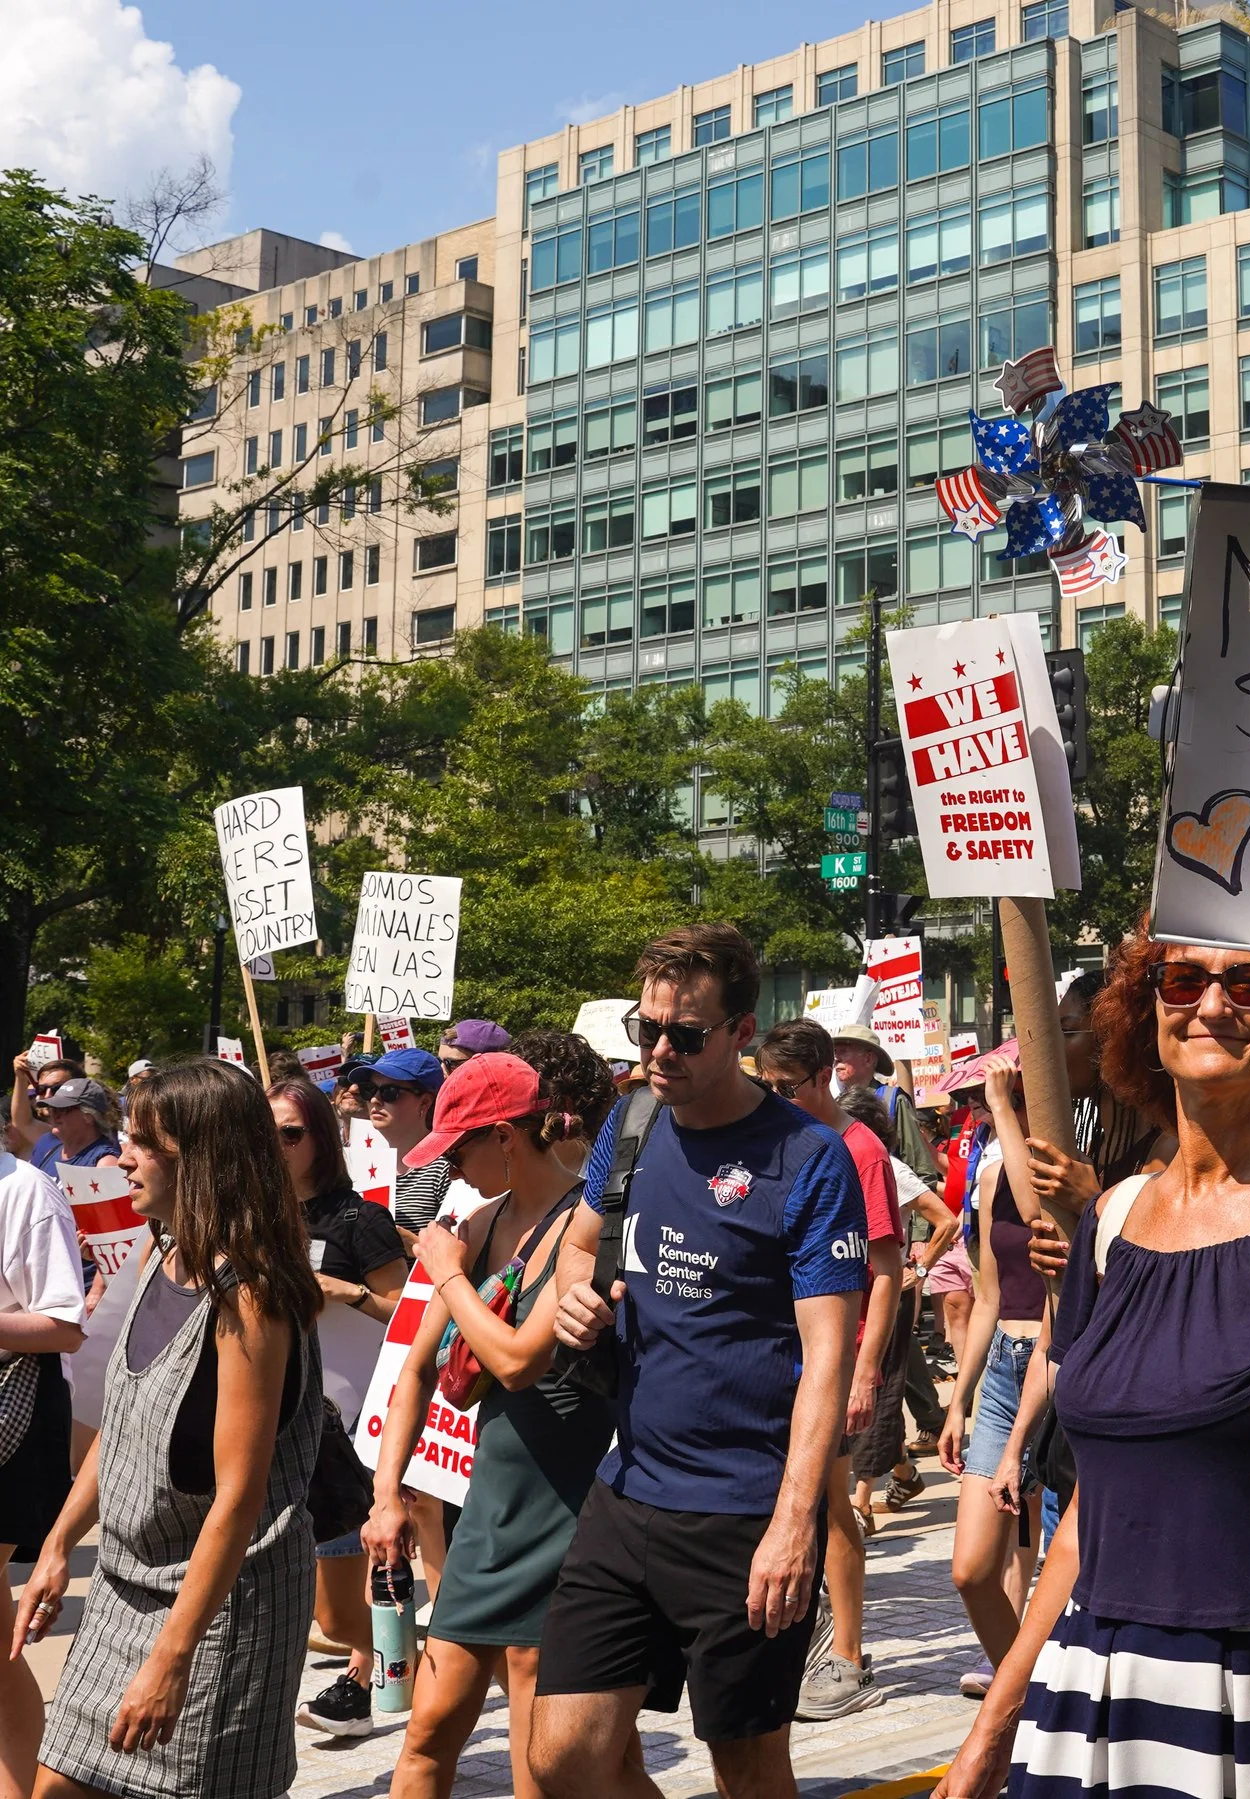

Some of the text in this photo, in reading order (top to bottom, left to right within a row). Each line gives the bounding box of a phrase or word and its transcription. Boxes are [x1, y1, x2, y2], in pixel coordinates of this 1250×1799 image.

[935, 680, 1001, 728] WE
[928, 724, 1023, 781] HAVE
[940, 789, 1026, 806] the RIGHT to
[221, 797, 281, 844] HARD
[827, 812, 846, 829] 16th
[940, 811, 1032, 834] FREEDOM
[835, 833, 860, 846] 900
[946, 839, 1034, 862] & SAFETY
[834, 856, 846, 875] K
[361, 874, 435, 905] SOMOS
[831, 876, 858, 889] 1600
[233, 879, 296, 930] ASSET
[238, 911, 315, 963] COUNTRY
[392, 950, 442, 979] LAS
[877, 981, 921, 1006] ROTEJA
[894, 1033, 906, 1044] DC
[660, 1225, 685, 1245] The
[658, 1243, 719, 1270] Kennedy
[831, 1231, 869, 1265] ally
[657, 1261, 704, 1282] Center
[655, 1279, 713, 1300] 50 Years
